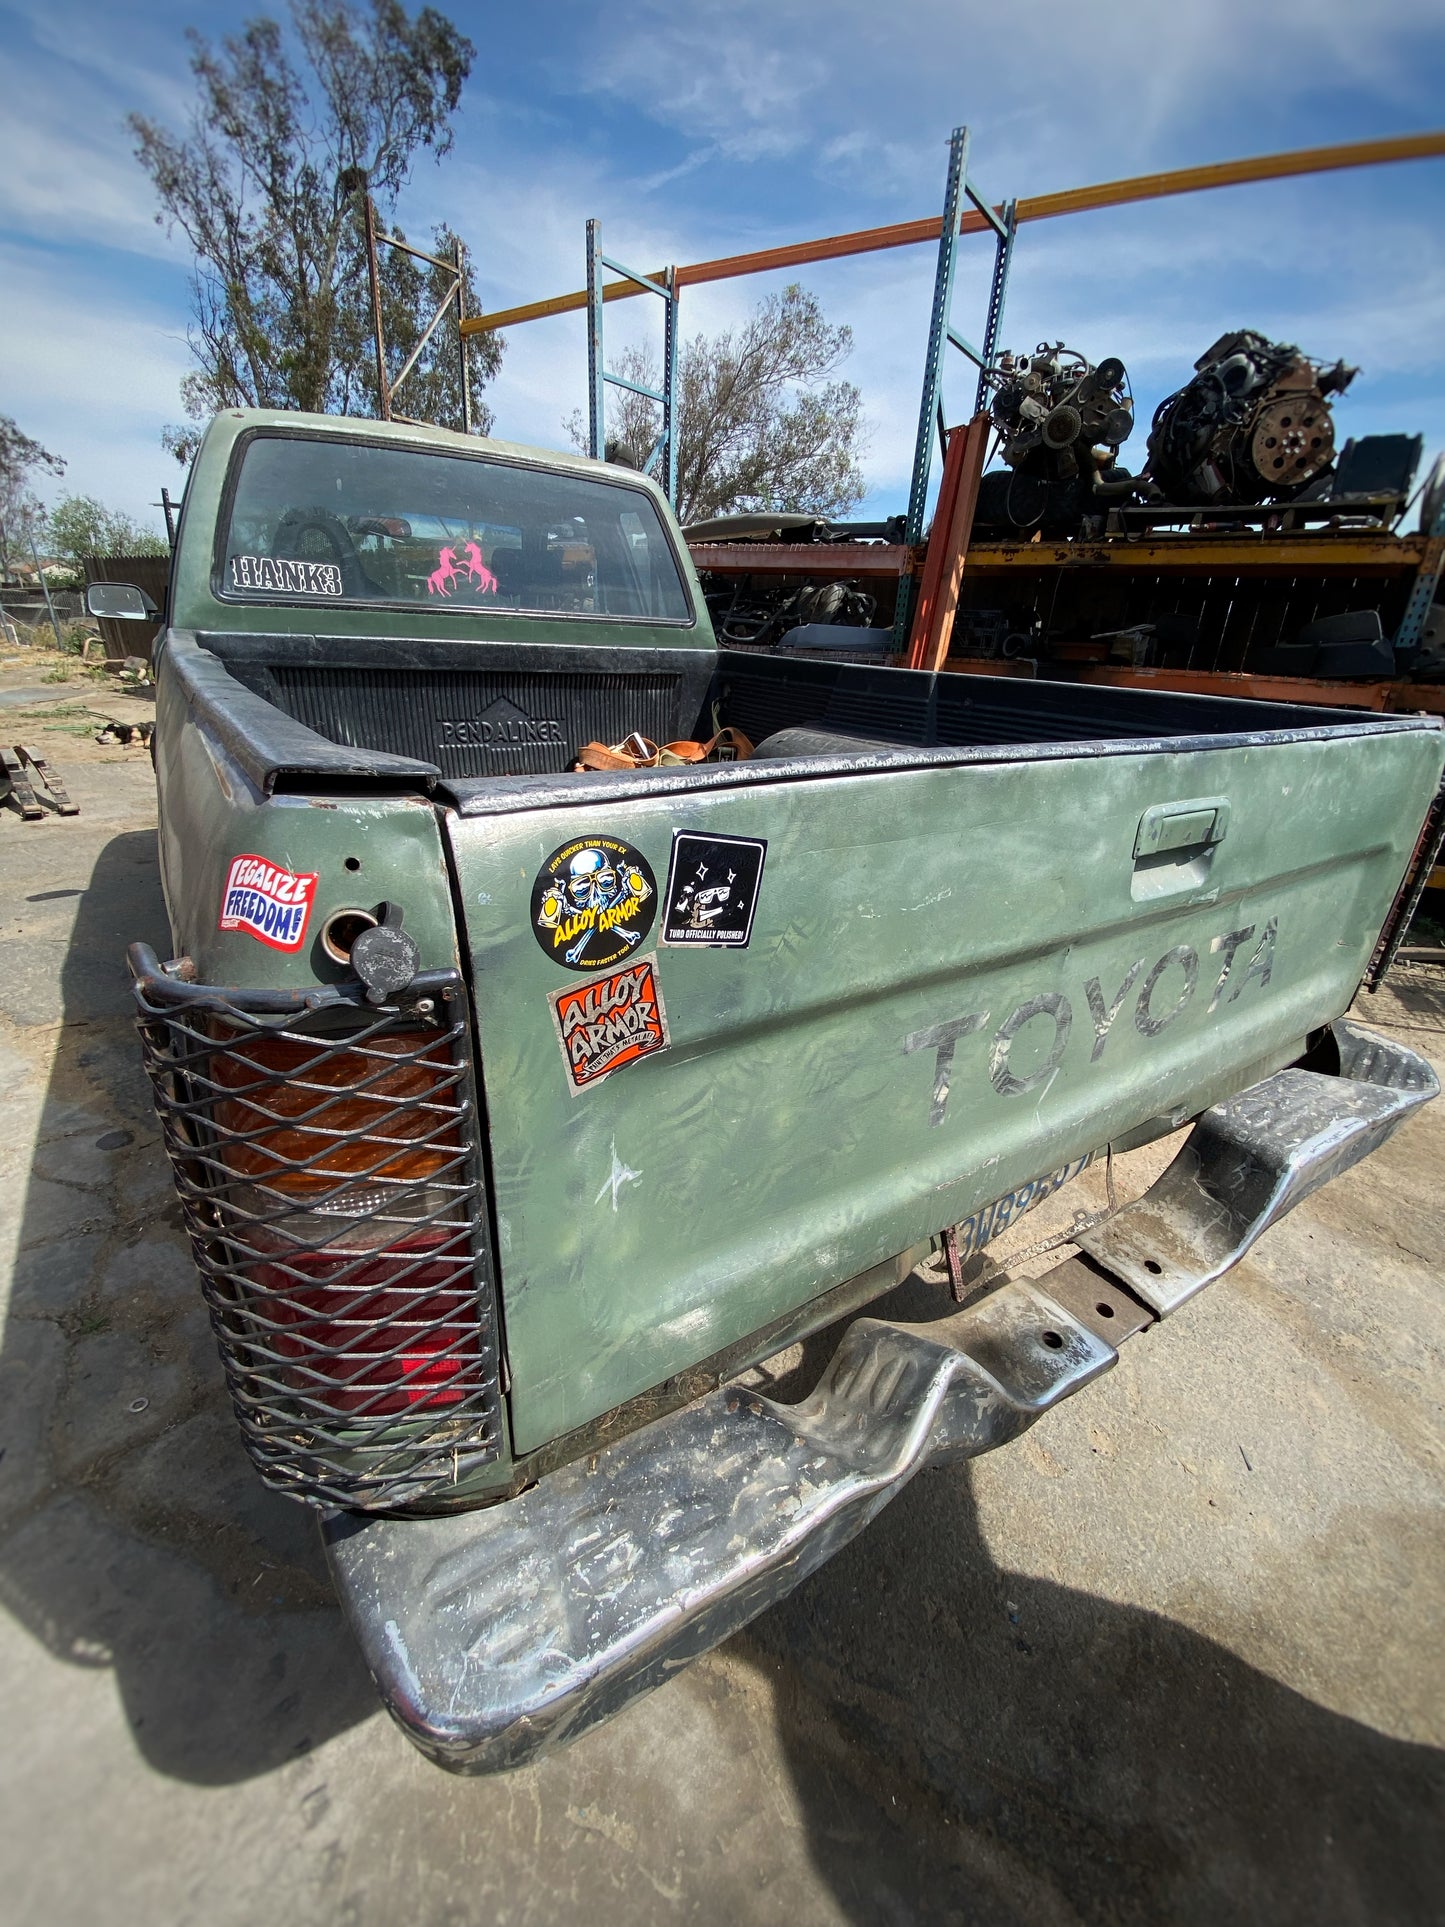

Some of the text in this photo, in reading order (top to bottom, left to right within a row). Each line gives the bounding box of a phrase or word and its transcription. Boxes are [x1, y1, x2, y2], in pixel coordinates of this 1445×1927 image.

[232, 556, 343, 596] HANK3
[442, 720, 562, 744] PENDALINER
[548, 840, 627, 873] LAYS QUICKER THAN YOUR EX
[228, 858, 312, 902] LEGALIZE
[226, 890, 304, 941] FREEDOM!
[553, 896, 641, 948] ALLOY ARMOR
[669, 929, 744, 940] TURD OFFICIALLY POLISHED!
[596, 953, 618, 966] FASTER
[564, 964, 650, 1038] ALLOY
[903, 915, 1279, 1128] TOYOTA
[571, 1002, 658, 1064] ARMOR
[588, 1057, 604, 1071] PAINT
[622, 1035, 642, 1046] METAL
